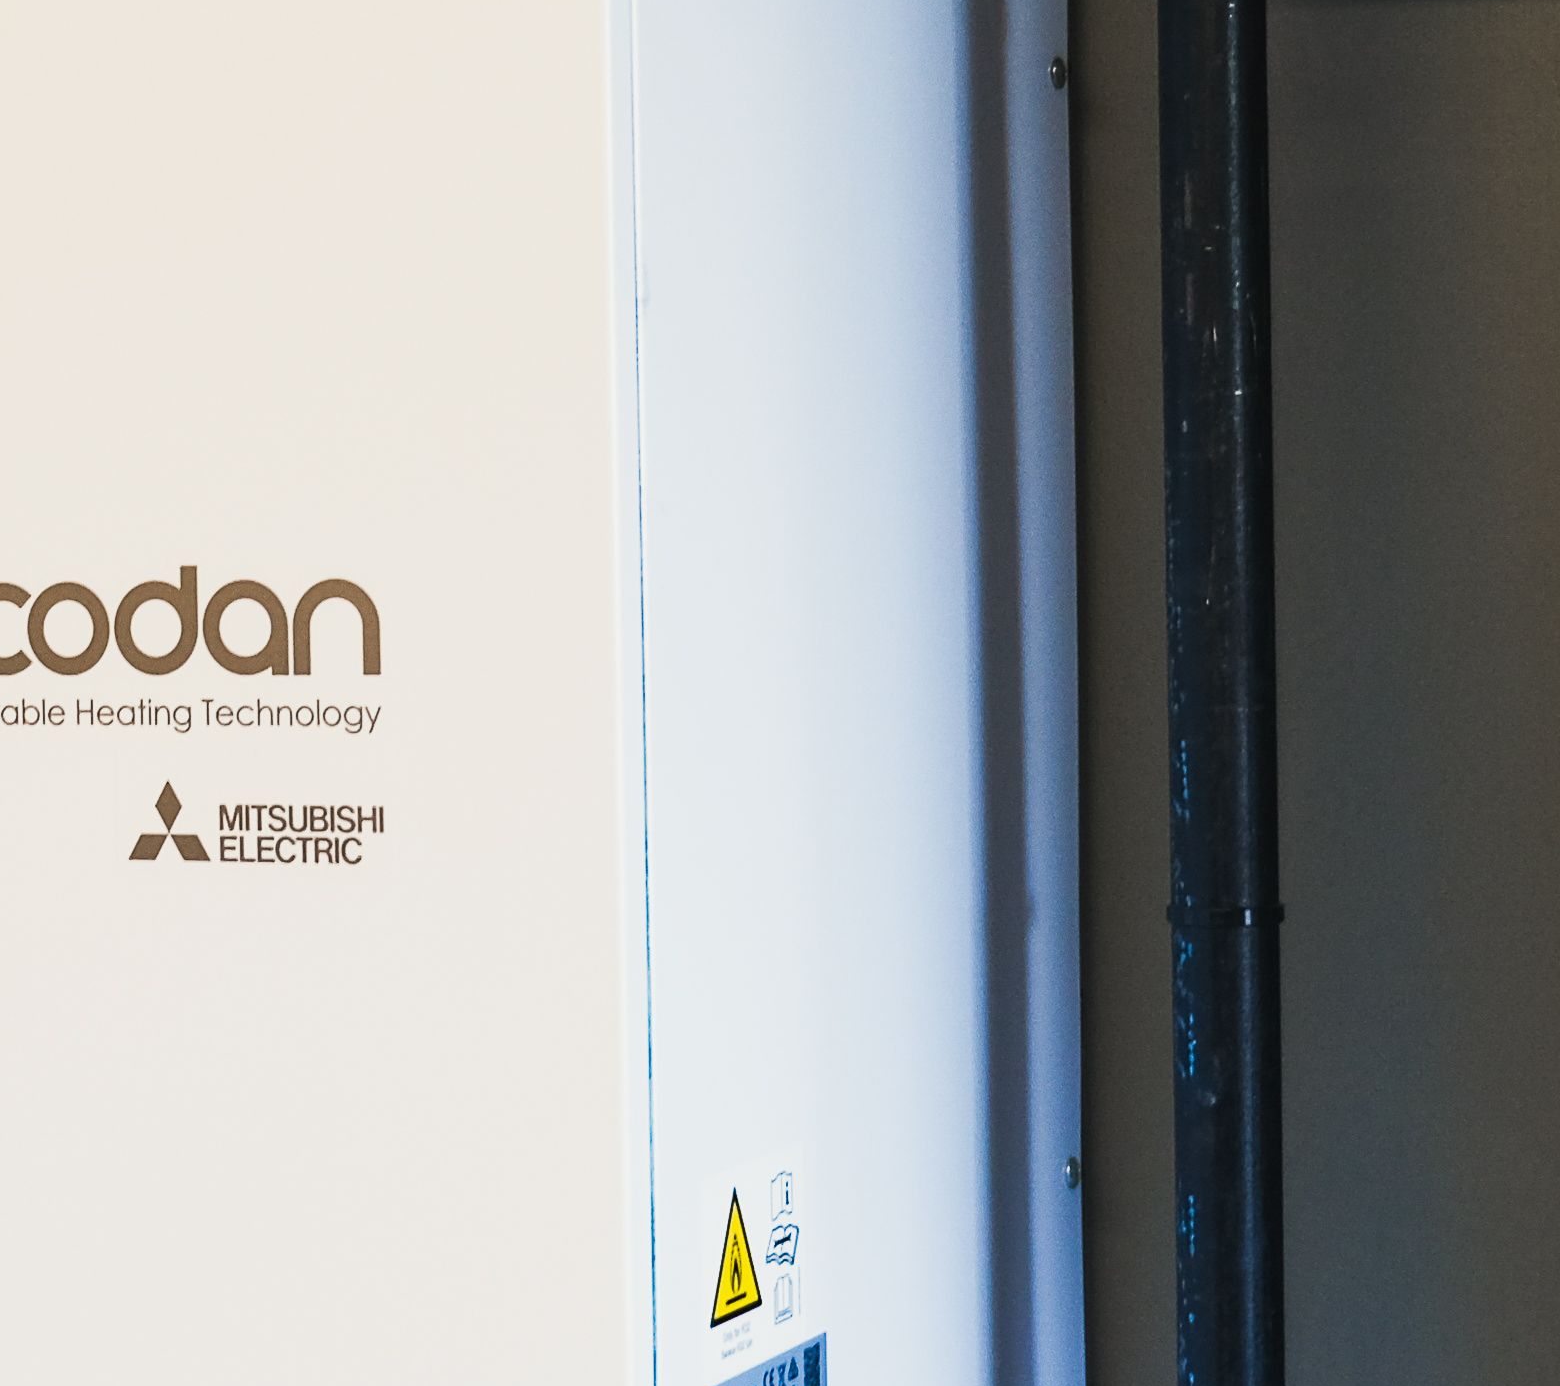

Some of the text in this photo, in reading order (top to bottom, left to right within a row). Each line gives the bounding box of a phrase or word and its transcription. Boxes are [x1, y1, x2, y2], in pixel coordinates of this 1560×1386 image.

[76, 699, 193, 733] Heating
[201, 699, 382, 734] Technology
[218, 804, 385, 833] MITSUBISHI
[218, 836, 363, 865] ELECTRIC
